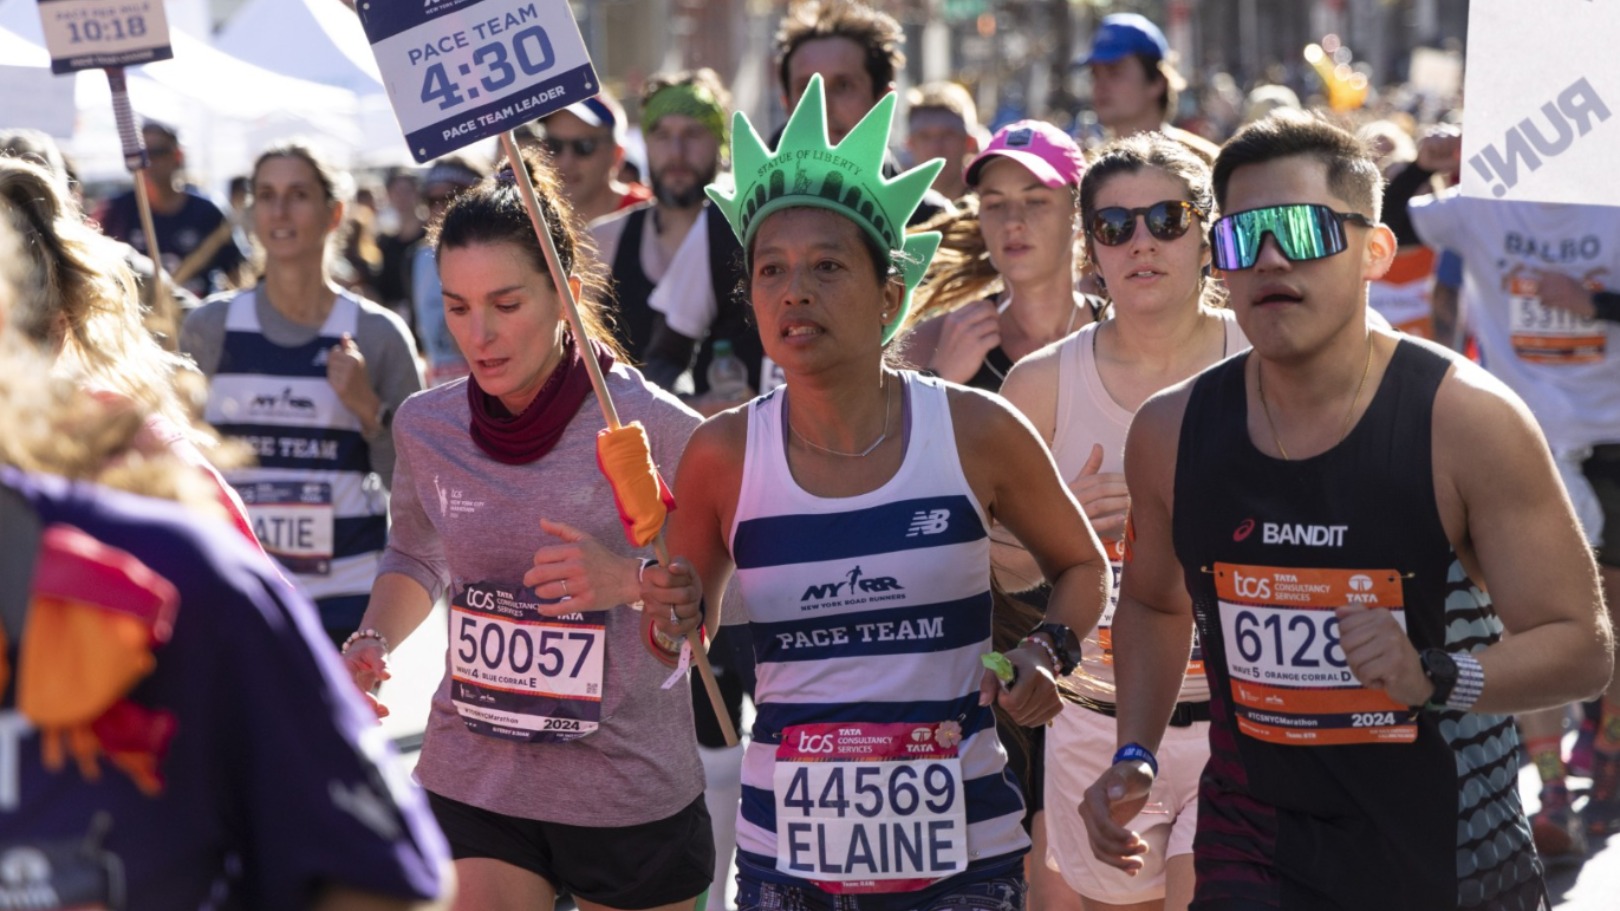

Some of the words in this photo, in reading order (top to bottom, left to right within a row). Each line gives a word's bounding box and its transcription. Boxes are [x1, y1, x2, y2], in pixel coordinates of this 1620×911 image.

[67, 16, 147, 43] 10:18
[408, 31, 470, 66] PACE
[472, 3, 538, 40] TEAM
[420, 25, 555, 111] 4:30
[442, 120, 477, 141] PACE
[480, 107, 514, 127] TEAM
[516, 85, 565, 113] LEADER
[757, 151, 793, 177] STATUE
[796, 149, 811, 160] OF
[812, 149, 862, 176] LIBERTY
[1504, 231, 1601, 264] BALBO
[278, 436, 339, 460] TEAM
[251, 516, 315, 549] ATIE
[905, 508, 951, 538] NB
[1262, 522, 1349, 547] BANDIT
[1234, 570, 1271, 599] tcs
[1273, 573, 1298, 583] TATA
[1274, 584, 1331, 594] CONSULTANCY
[466, 587, 495, 611] tcs
[496, 590, 514, 600] TATA
[800, 604, 819, 612] NEW
[821, 600, 843, 610] YORK
[845, 598, 867, 606] ROAD
[869, 593, 906, 603] RUNNERS
[1275, 592, 1311, 602] SERVICES
[1345, 593, 1379, 604] TATA
[497, 605, 524, 618] SERVICES
[776, 626, 850, 650] PACE
[856, 616, 945, 643] TEAM
[1234, 610, 1350, 668] 6128
[458, 616, 595, 678] 50057
[472, 668, 479, 679] 4
[482, 672, 498, 683] BLUE
[498, 676, 528, 686] CORRAL
[529, 677, 538, 688] E
[1232, 664, 1251, 676] WAVE
[1252, 667, 1260, 679] 5
[1264, 670, 1300, 682] ORANGE
[1301, 671, 1340, 682] CORRAL
[1341, 670, 1352, 682] D
[543, 719, 581, 731] 2024
[1351, 711, 1396, 727] 2024
[798, 730, 834, 754] tcs
[838, 728, 862, 736] TATA
[838, 736, 893, 745] CONSULTANCY
[838, 745, 873, 754] SERVICES
[905, 744, 935, 753] TATA
[784, 763, 956, 818] 44569
[787, 820, 957, 875] ELAINE
